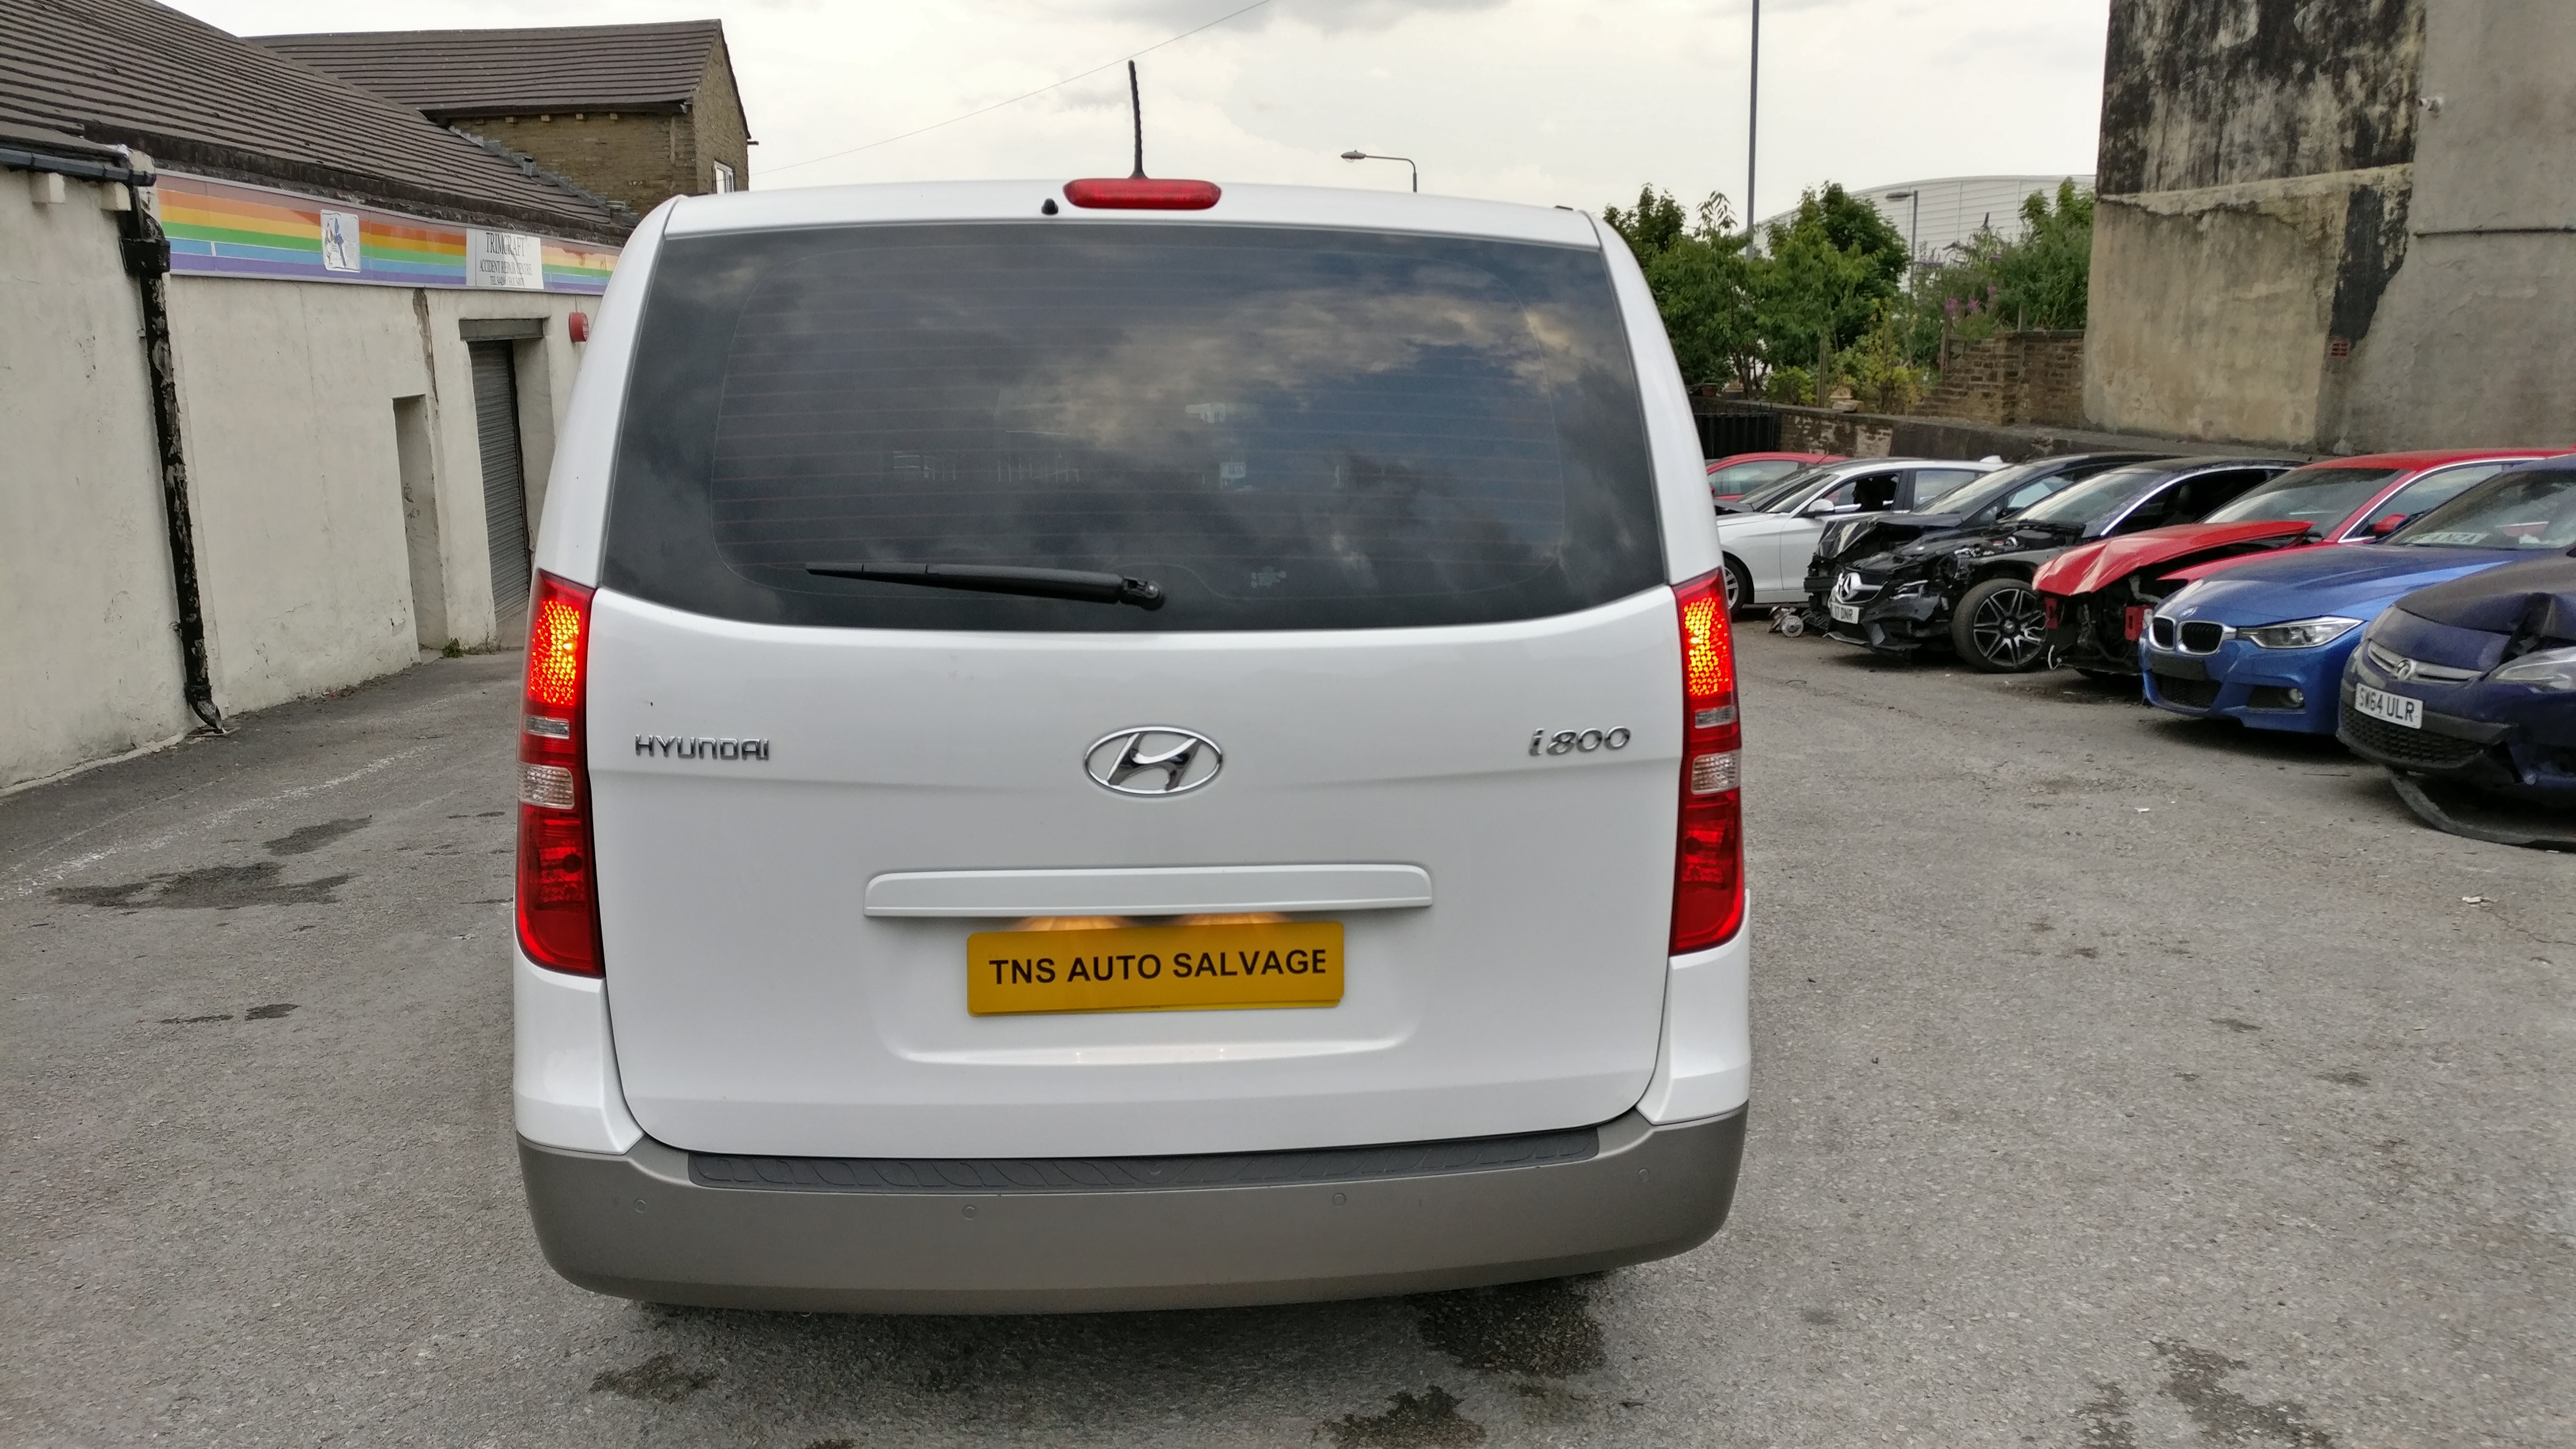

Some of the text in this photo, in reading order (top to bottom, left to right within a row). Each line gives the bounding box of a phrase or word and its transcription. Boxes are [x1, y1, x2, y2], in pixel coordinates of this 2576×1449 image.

[486, 232, 525, 257] TRIMCRAFT
[480, 259, 532, 275] ACCIDENT REPAIR CENTRE
[2387, 696, 2414, 722] ULR
[635, 734, 769, 761] HYUNDAI
[1528, 726, 1631, 756] i800
[989, 949, 1326, 985] TNS AUTO SALVAGE
